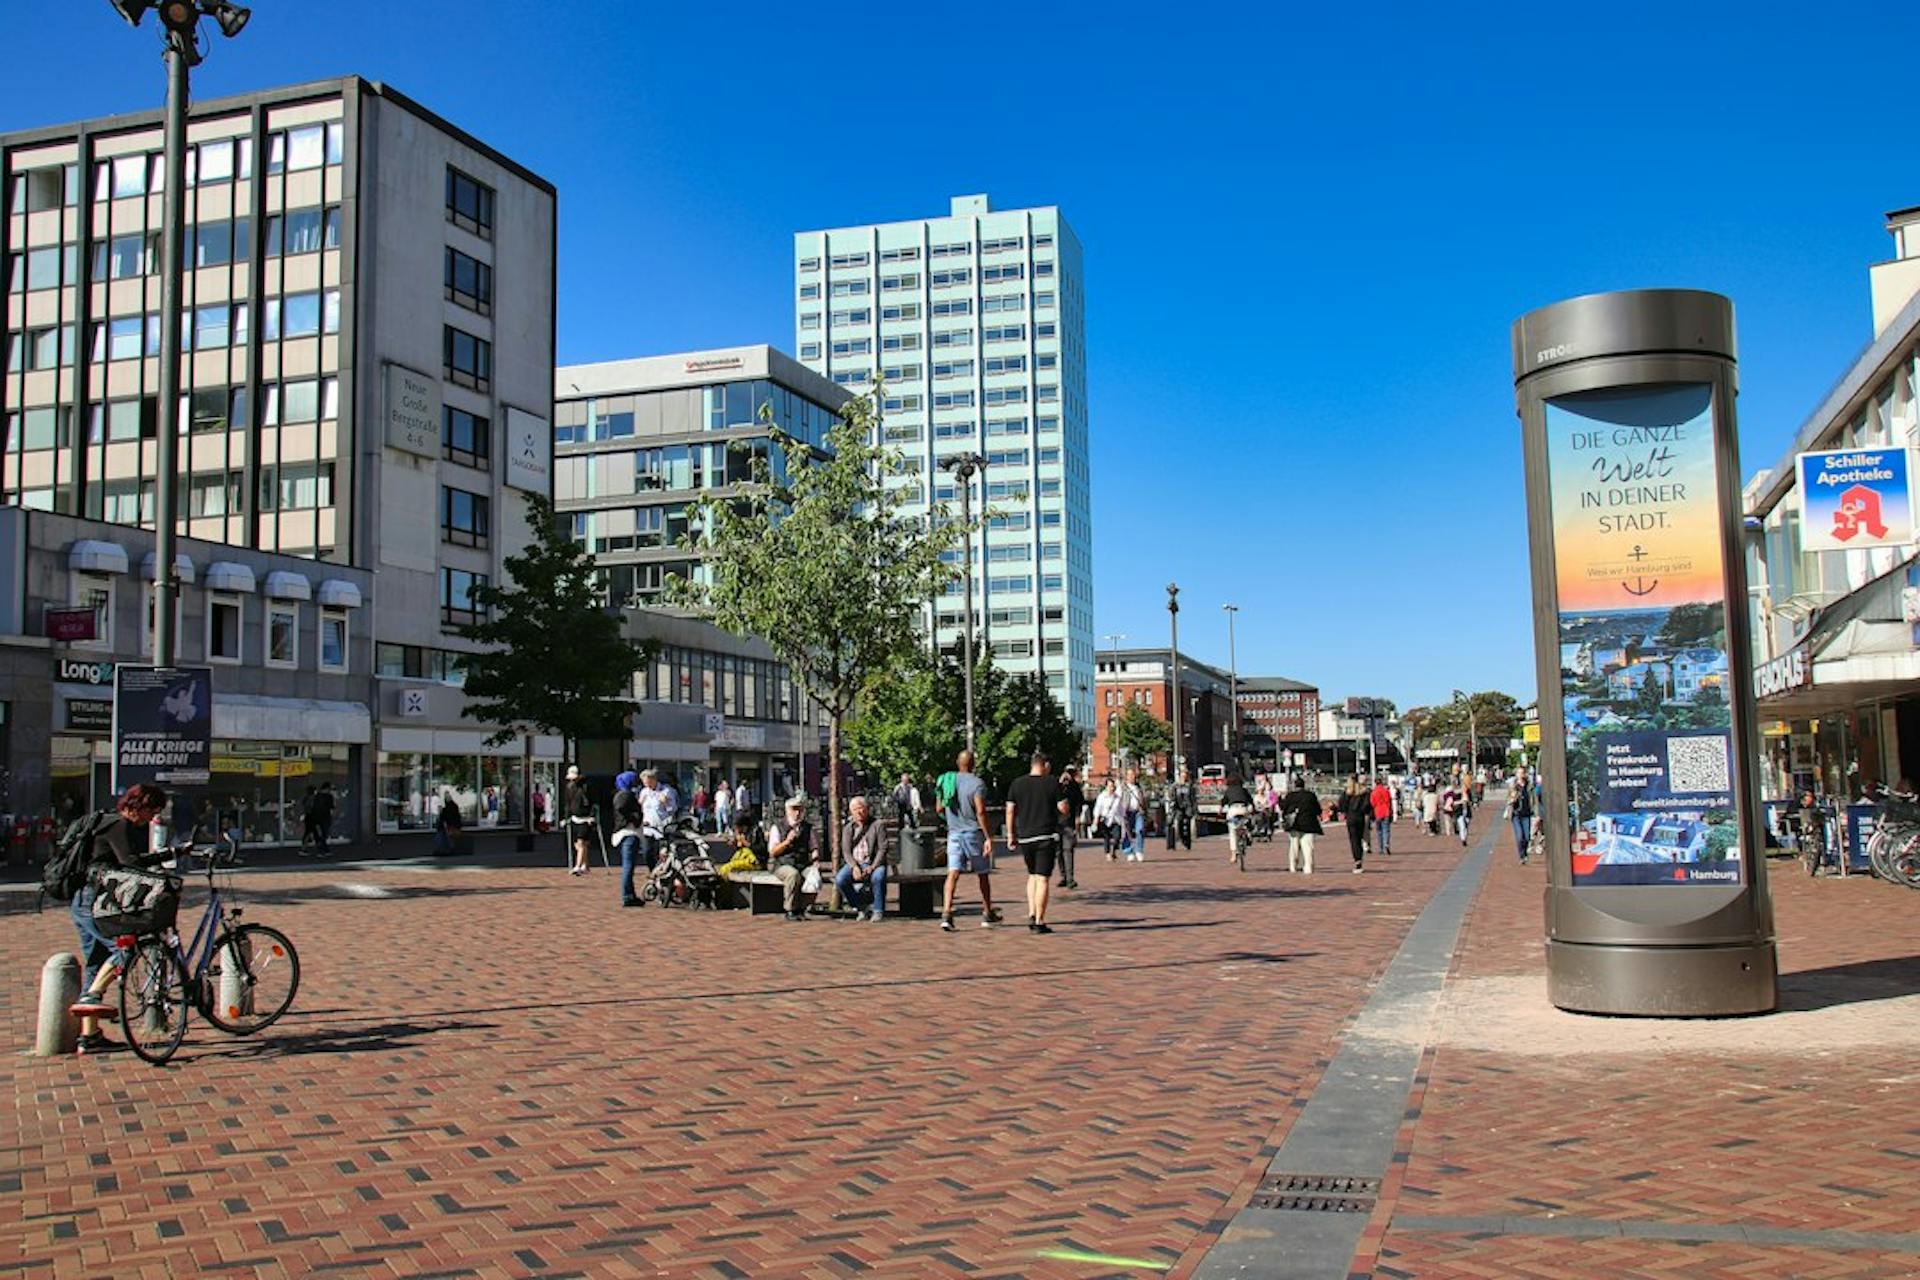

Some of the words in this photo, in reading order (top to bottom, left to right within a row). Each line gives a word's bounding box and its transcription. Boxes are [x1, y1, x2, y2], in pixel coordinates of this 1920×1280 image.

[404, 379, 427, 395] Neue
[402, 395, 428, 414] Große
[392, 410, 438, 434] Bergstraße
[1572, 431, 1605, 450] DIE
[1612, 425, 1687, 446] GANZE
[1592, 446, 1677, 482] Welt
[1825, 453, 1883, 469] Schiller
[1816, 467, 1893, 487] Apotheke
[1580, 490, 1601, 508] IN
[1608, 483, 1686, 506] DEINER
[1599, 511, 1672, 533] STADT.
[1626, 563, 1670, 573] Hamburg
[121, 741, 154, 753] ALLE
[156, 741, 205, 753] KRIEGE
[1607, 744, 1631, 754] Jetzt
[121, 753, 189, 766] BEENDEN!
[1607, 755, 1658, 765] Frankreich
[1619, 766, 1663, 777] Hamburg
[1608, 777, 1648, 788] erleben!
[1632, 797, 1730, 808] dieweltinhamburg.de
[1689, 869, 1738, 881] Hamburg
